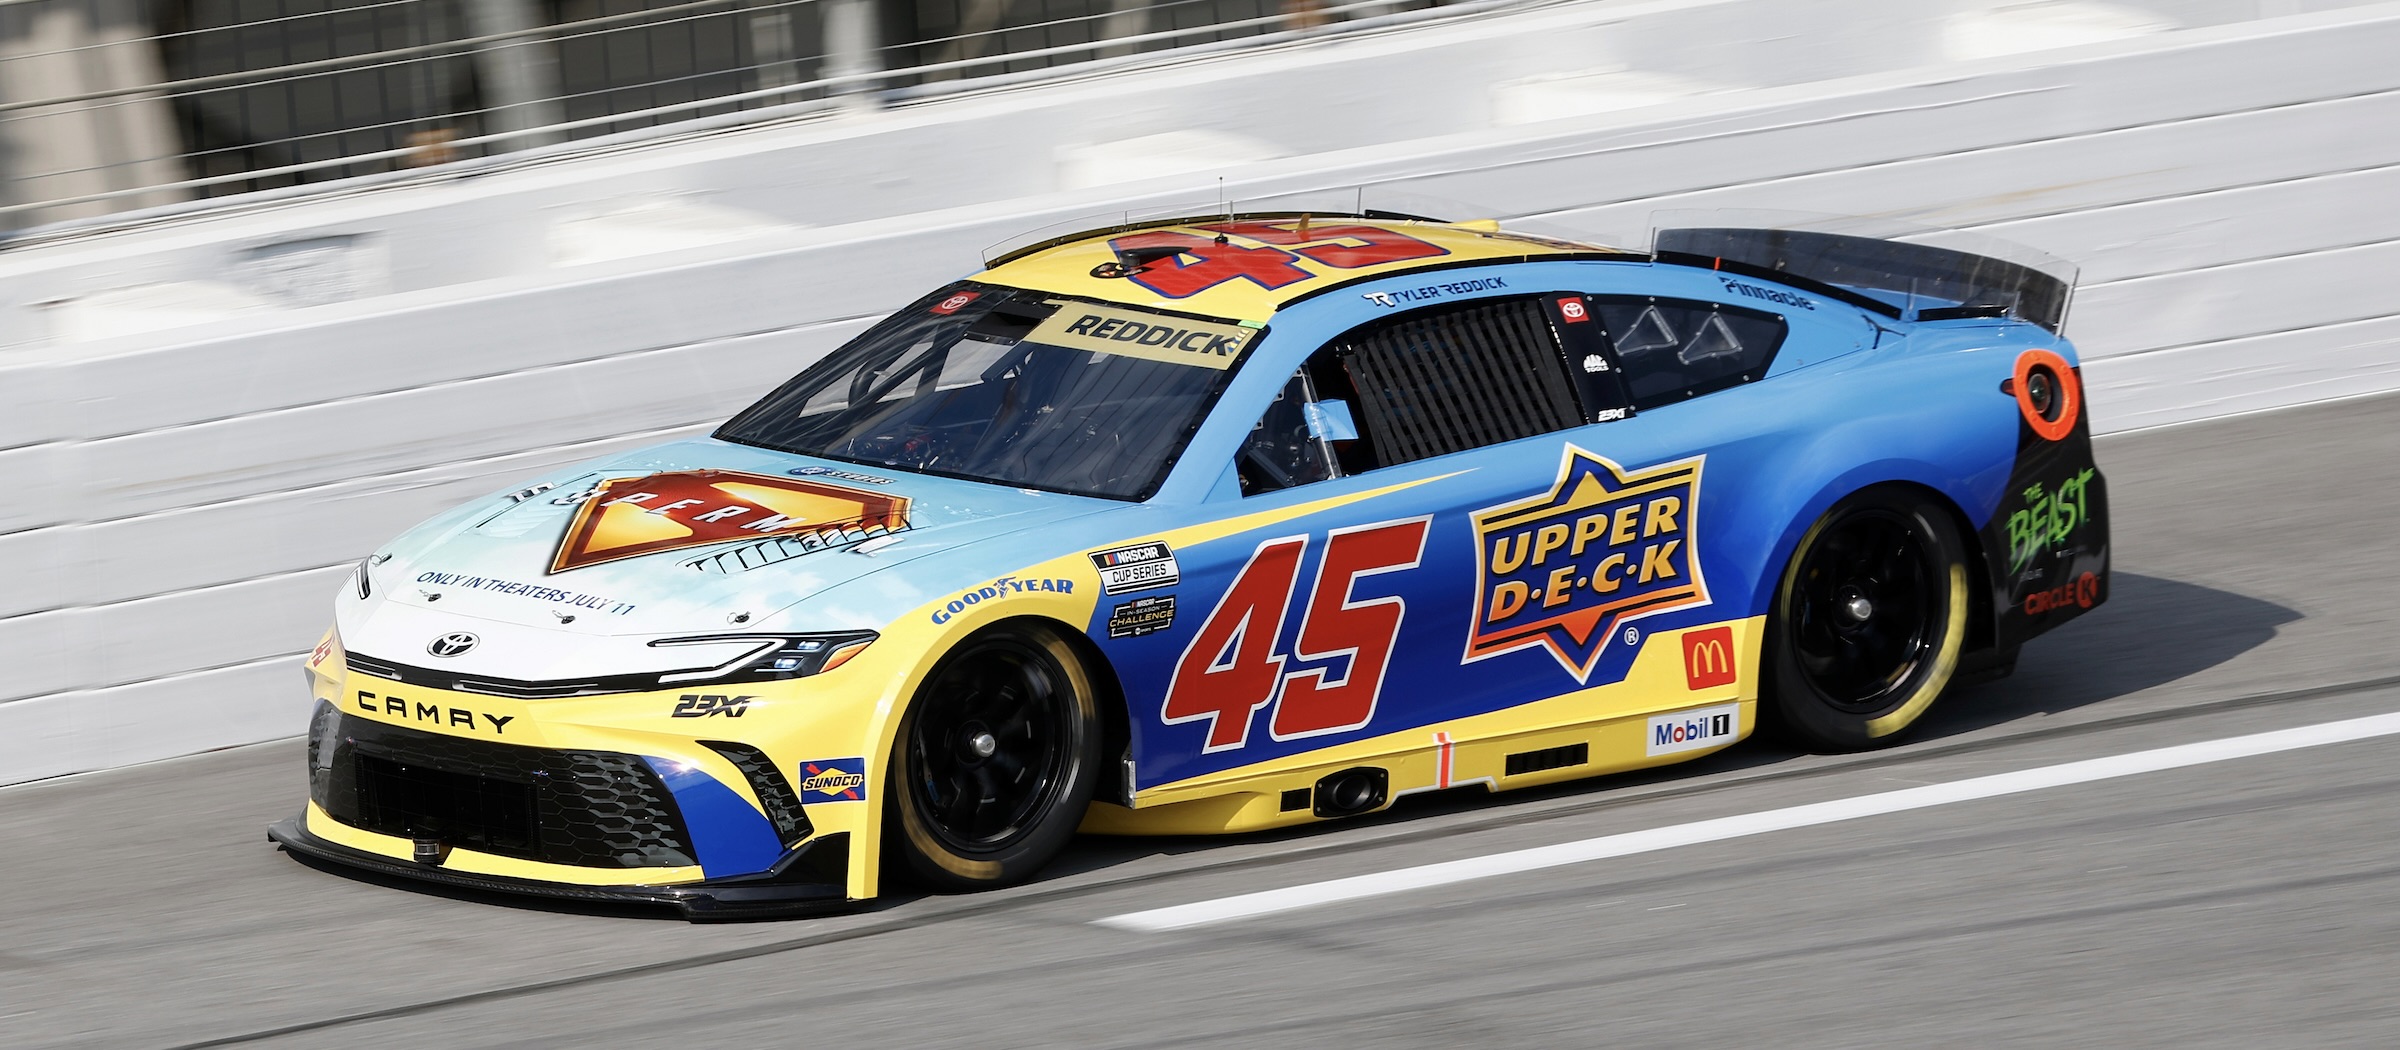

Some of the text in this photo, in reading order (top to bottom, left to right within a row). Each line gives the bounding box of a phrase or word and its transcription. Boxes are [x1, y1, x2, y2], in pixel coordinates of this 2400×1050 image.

[1106, 221, 1452, 300] 45
[1388, 285, 1440, 303] TYLER
[1438, 277, 1508, 295] REDDICK
[1718, 276, 1815, 311] Pinnacle
[1064, 314, 1235, 356] REDDICK
[2022, 481, 2044, 503] THE
[1490, 496, 1682, 575] UPPER
[2004, 467, 2095, 576] BEAST
[1116, 546, 1160, 564] NASCAR
[1112, 563, 1166, 583] CUP SERIES
[416, 571, 636, 616] ONLY IN THEATERS JULY 11
[2024, 583, 2075, 615] CIRCLE
[1109, 609, 1174, 628] CHALLENGE
[1160, 513, 1435, 755] 45
[358, 690, 515, 734] CAMRY
[1655, 714, 1730, 747] Mobil 1
[804, 774, 862, 790] SUNOCO
